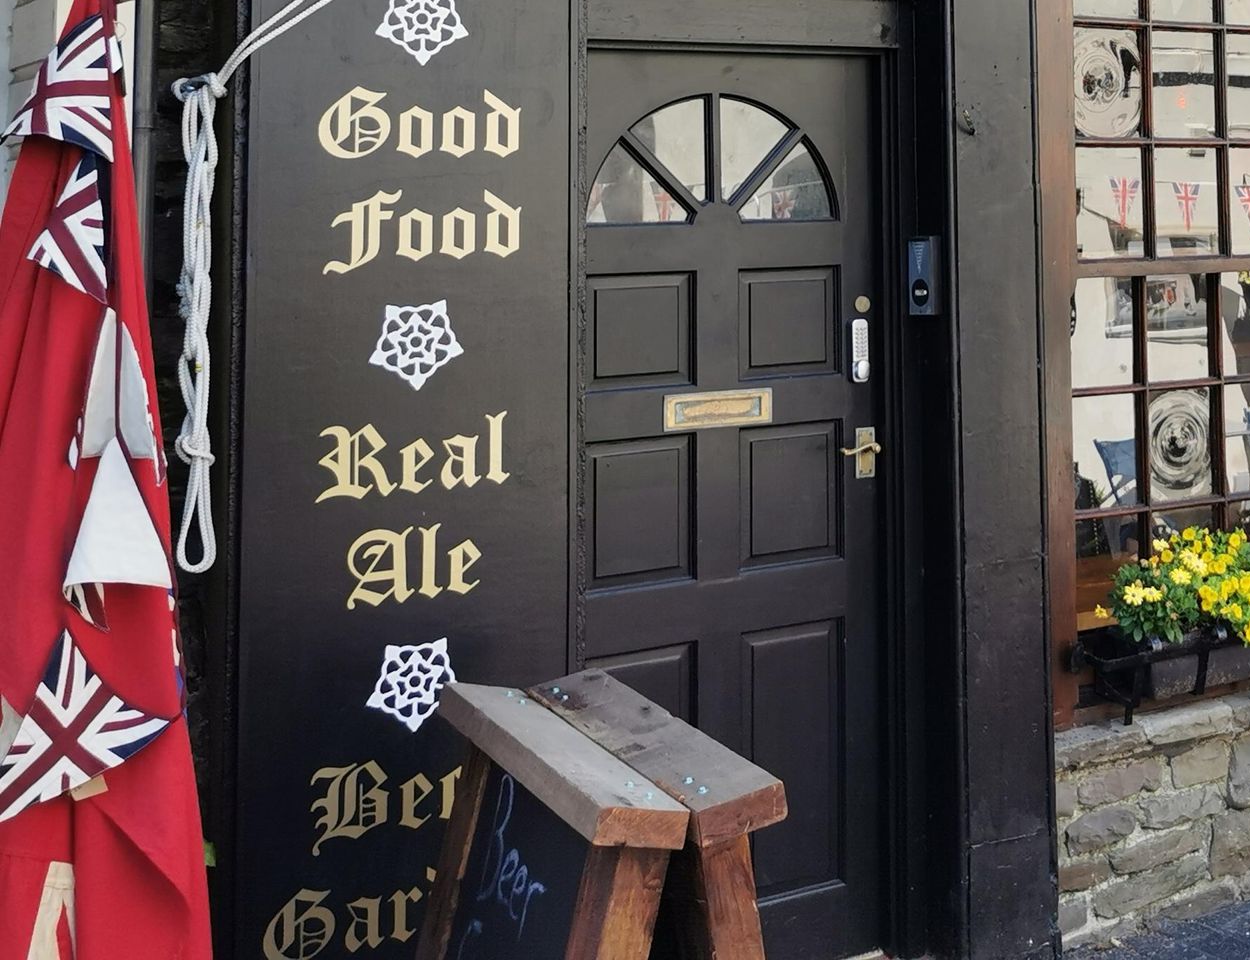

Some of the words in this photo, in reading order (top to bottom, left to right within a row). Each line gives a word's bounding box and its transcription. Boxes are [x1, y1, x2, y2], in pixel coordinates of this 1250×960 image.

[318, 85, 522, 159] Good
[322, 189, 522, 275] Food
[314, 410, 511, 503] Real
[347, 523, 482, 610] Ale
[310, 759, 462, 856] Be
[263, 866, 437, 960] Gar
